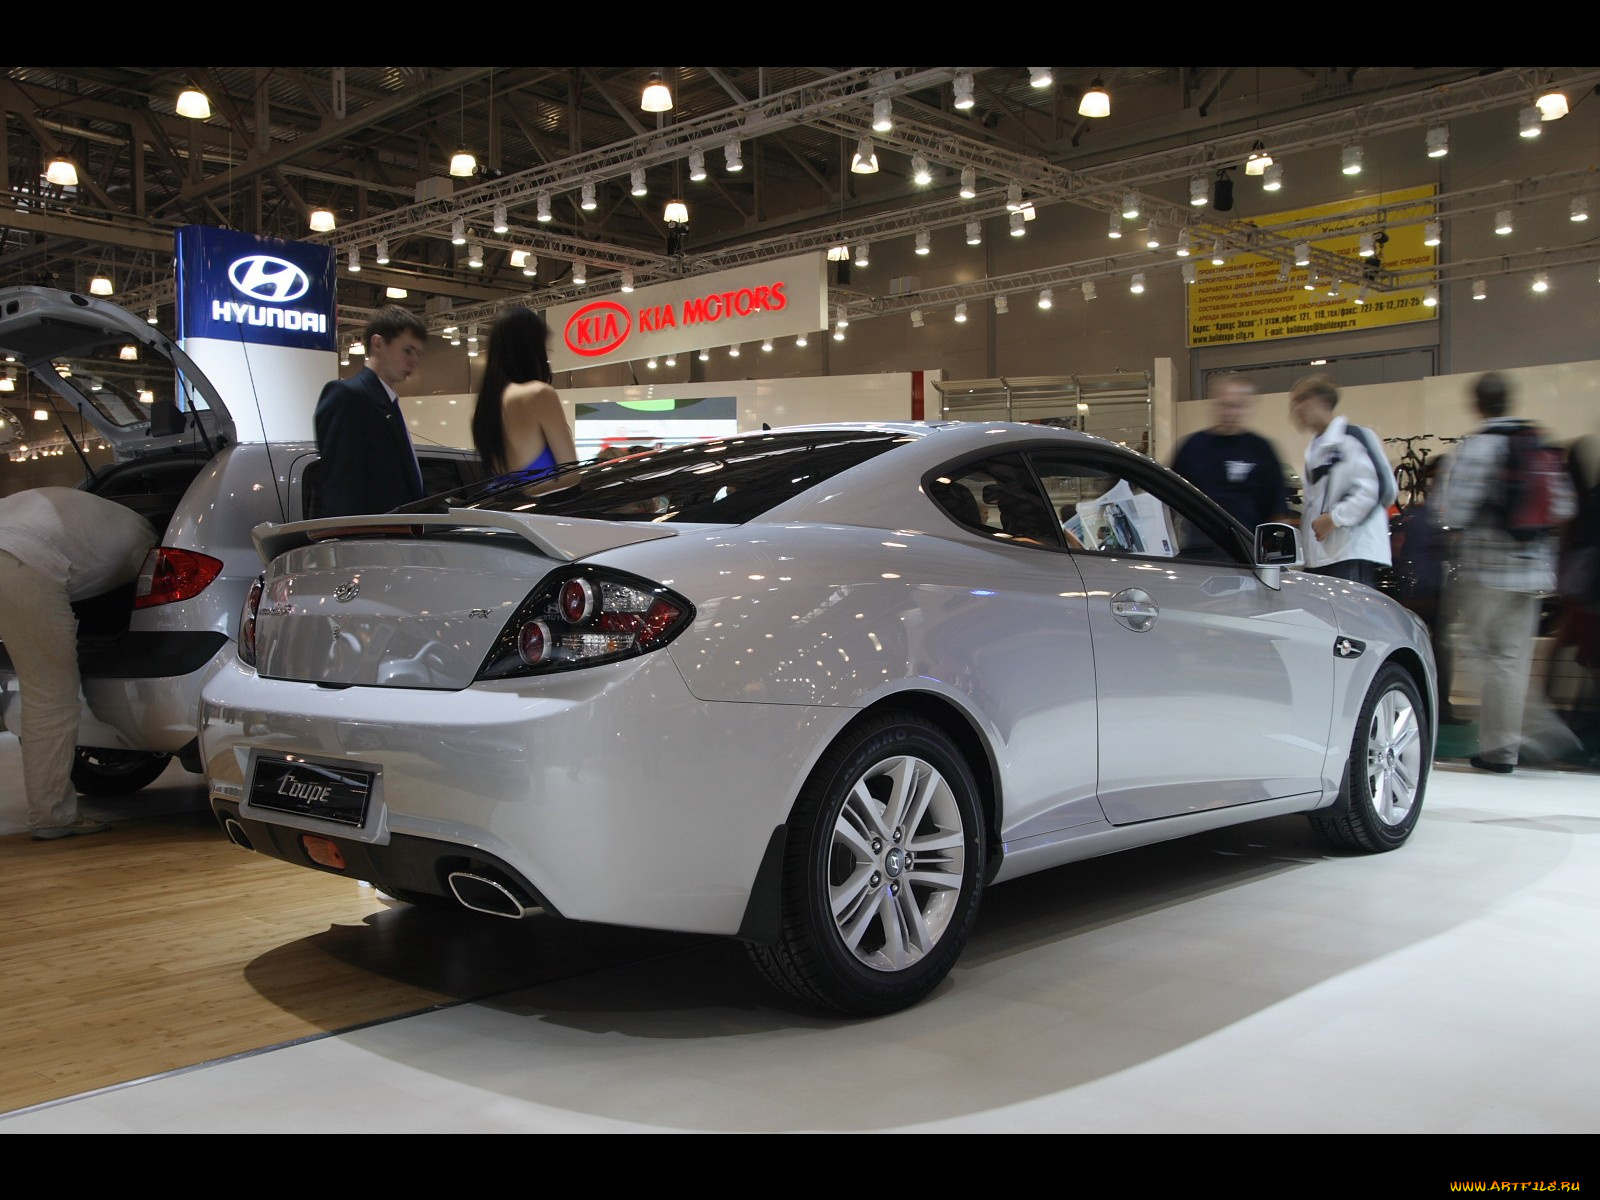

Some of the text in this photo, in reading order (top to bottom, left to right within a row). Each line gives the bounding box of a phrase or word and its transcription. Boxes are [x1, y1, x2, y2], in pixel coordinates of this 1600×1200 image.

[1198, 273, 1244, 284] СТРОИТЕЛЬСТВО
[1198, 284, 1232, 294] РАЗРАБОТКА
[1198, 294, 1230, 303] ЗАСТРОЙКА
[639, 281, 787, 333] KIA MOTORS
[1198, 295, 1294, 312] СОСТАВЛЕНИЕ ЭЛЕКТРОПРОЕКТОВ
[1198, 313, 1220, 321] АРЕНДА
[1221, 310, 1244, 318] МЕБЕЛИ
[1251, 304, 1297, 316] ВЫСТАВОЧНОГО
[1298, 298, 1347, 309] ОБОРУДОВАНИЯ
[212, 300, 327, 334] HYUNDAI
[577, 313, 619, 345] KIA
